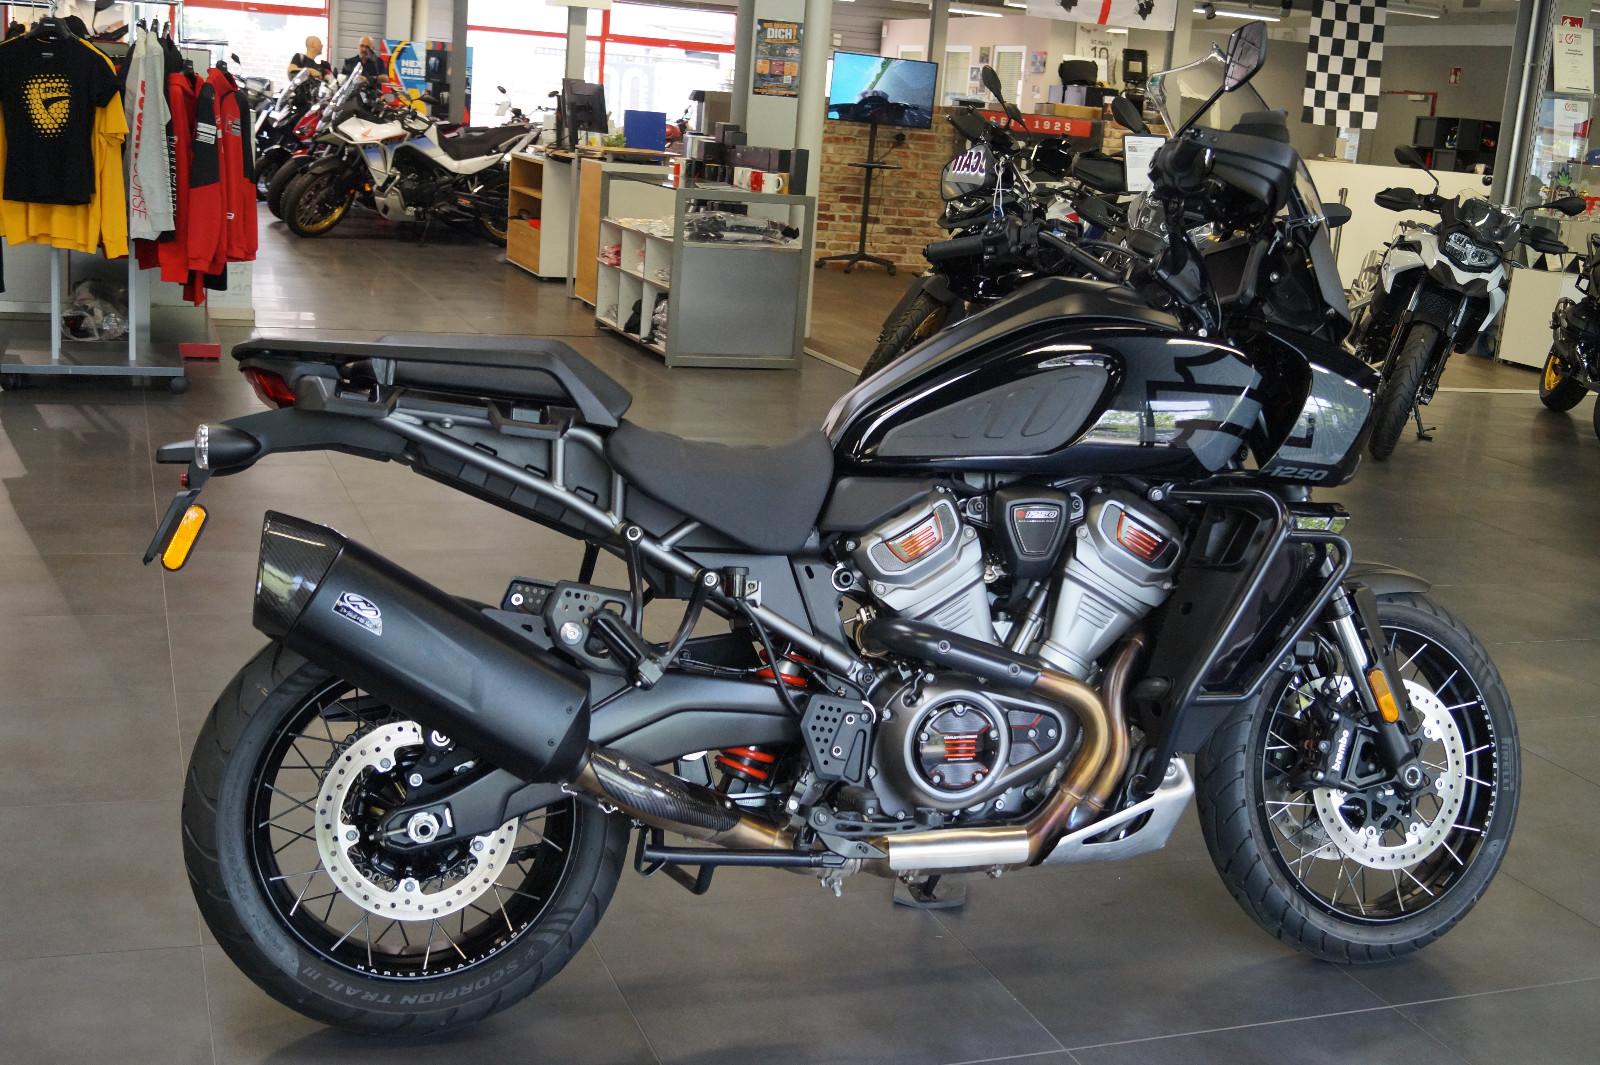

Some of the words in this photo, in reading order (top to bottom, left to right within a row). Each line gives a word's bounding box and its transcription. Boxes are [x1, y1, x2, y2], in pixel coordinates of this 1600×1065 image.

[1034, 120, 1072, 132] 1925
[1270, 465, 1329, 481] 1250
[1331, 729, 1350, 772] brembo
[357, 922, 528, 977] HARLEY-DAVIDSON
[327, 977, 391, 1004] TRAIL
[400, 960, 519, 1005] SCORPION
